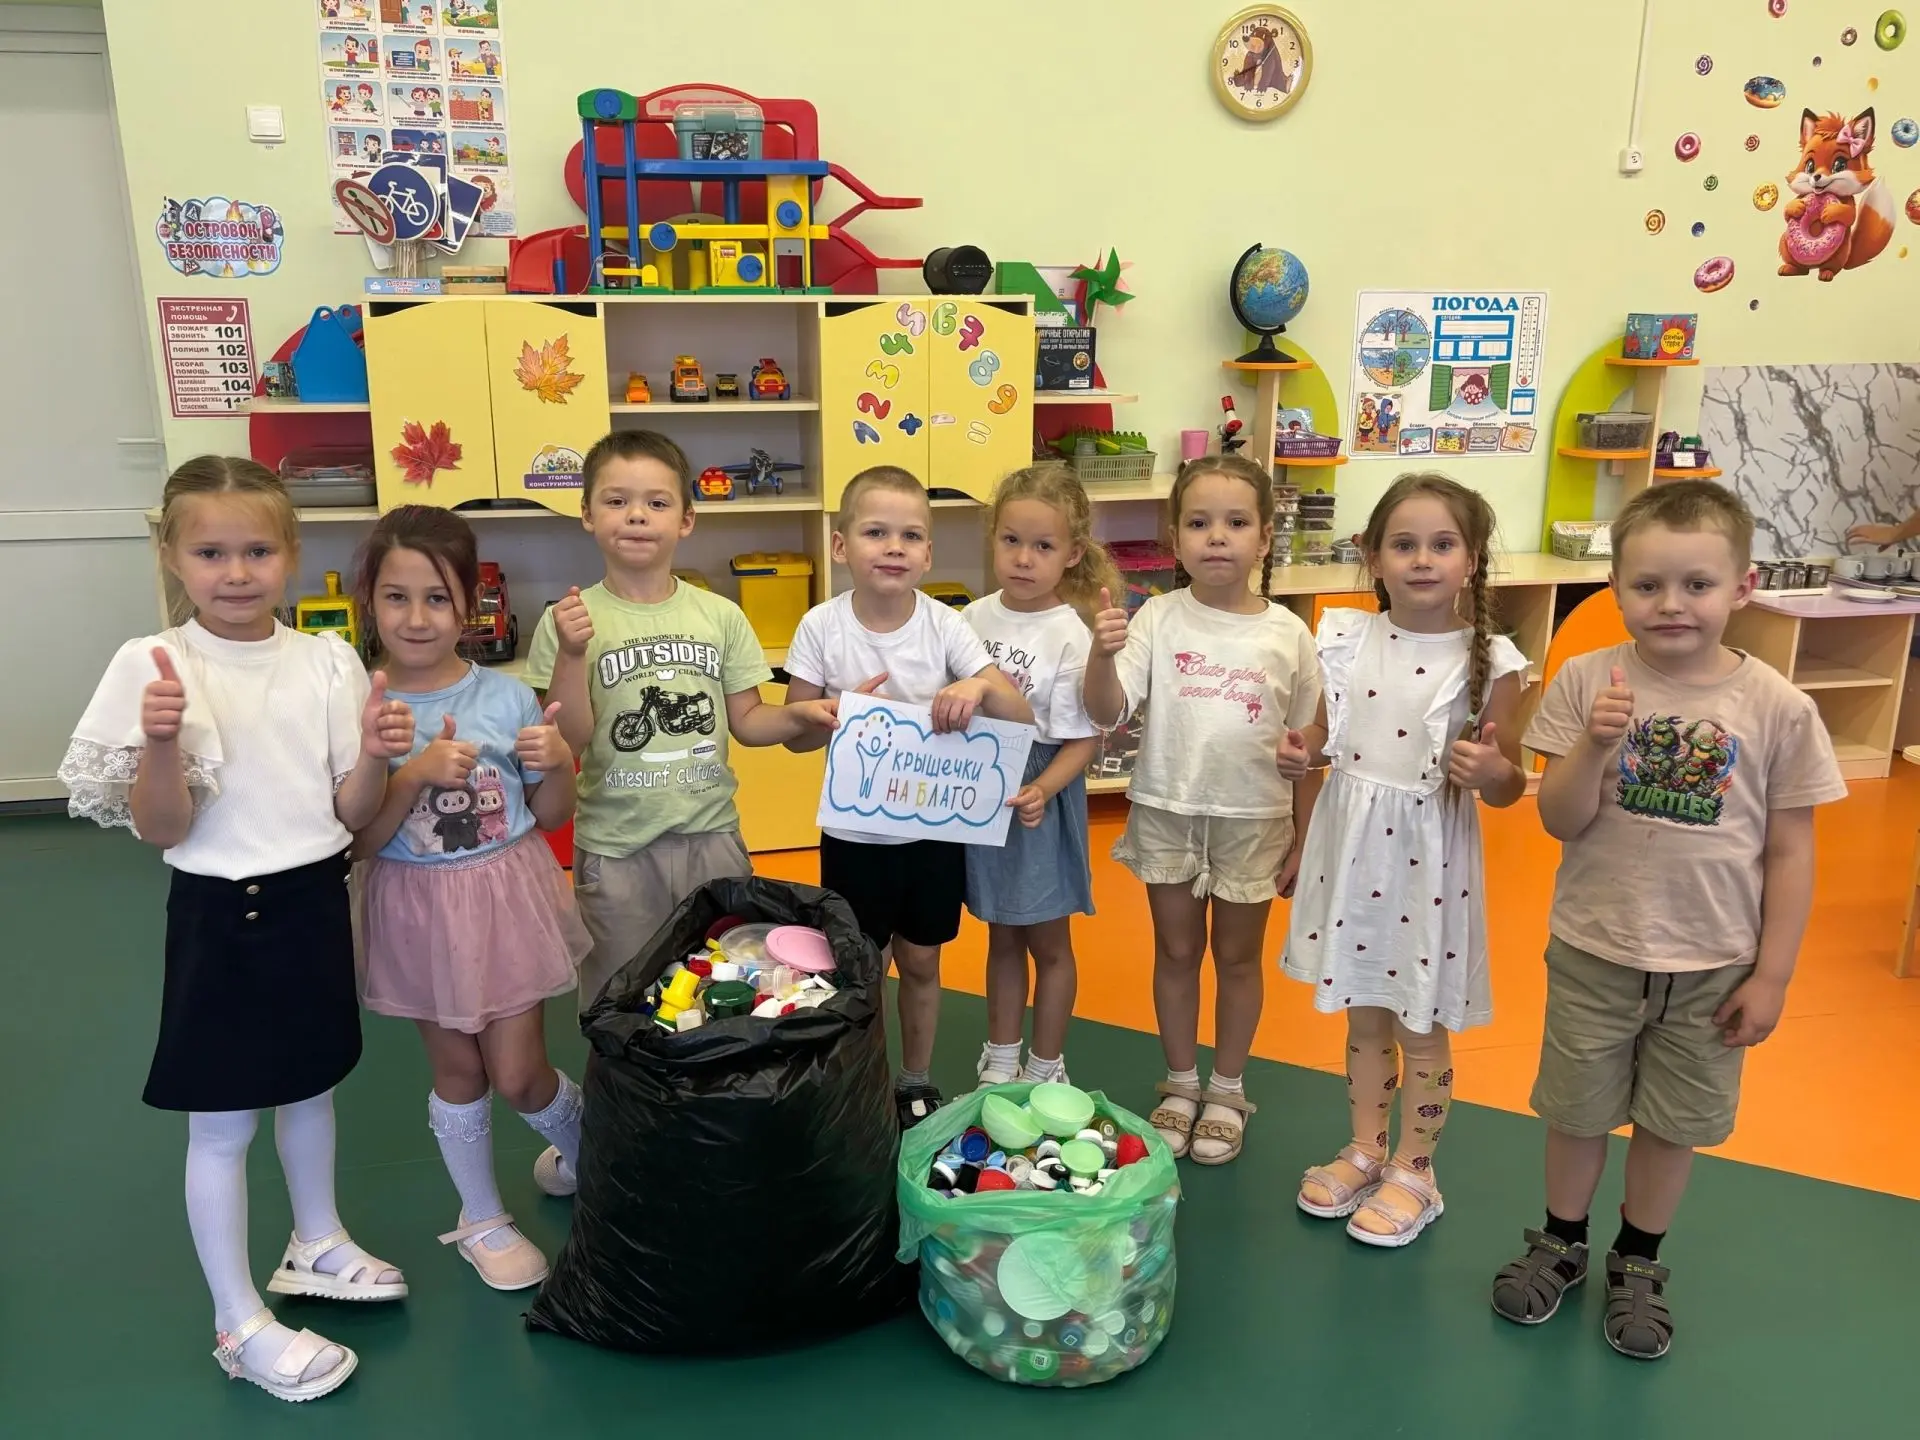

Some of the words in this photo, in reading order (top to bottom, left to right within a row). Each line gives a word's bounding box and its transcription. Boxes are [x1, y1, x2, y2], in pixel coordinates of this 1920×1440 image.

[1242, 26, 1248, 34] 11
[1259, 18, 1268, 27] 12
[1229, 40, 1239, 48] 10
[184, 222, 258, 239] ОСТРОВОК
[167, 243, 278, 260] БЕЗОПАСНОСТИ
[1432, 296, 1520, 313] ПОГОДА
[896, 303, 926, 336] 5
[932, 302, 957, 335] 6
[214, 326, 242, 338] 101
[959, 315, 984, 351] 7
[217, 344, 247, 356] 102
[880, 333, 913, 355] 4
[219, 362, 248, 374] 103
[866, 360, 899, 389] 3
[969, 350, 1000, 386] 8
[222, 380, 251, 391] 104
[857, 392, 891, 420] 2
[988, 384, 1017, 415] 9
[853, 420, 880, 444] 1
[623, 636, 640, 646] THE
[599, 640, 721, 688] OUTSIDER
[1005, 645, 1036, 669] YOU
[625, 671, 655, 683] WORLD
[1184, 651, 1226, 676] Cute
[1220, 667, 1267, 688] girls
[1179, 686, 1222, 698] wear
[605, 763, 672, 788] kitesurf
[676, 761, 721, 785] culture
[886, 778, 909, 804] НА
[915, 781, 977, 811] БЛАГО
[1622, 783, 1718, 821] TURTLES
